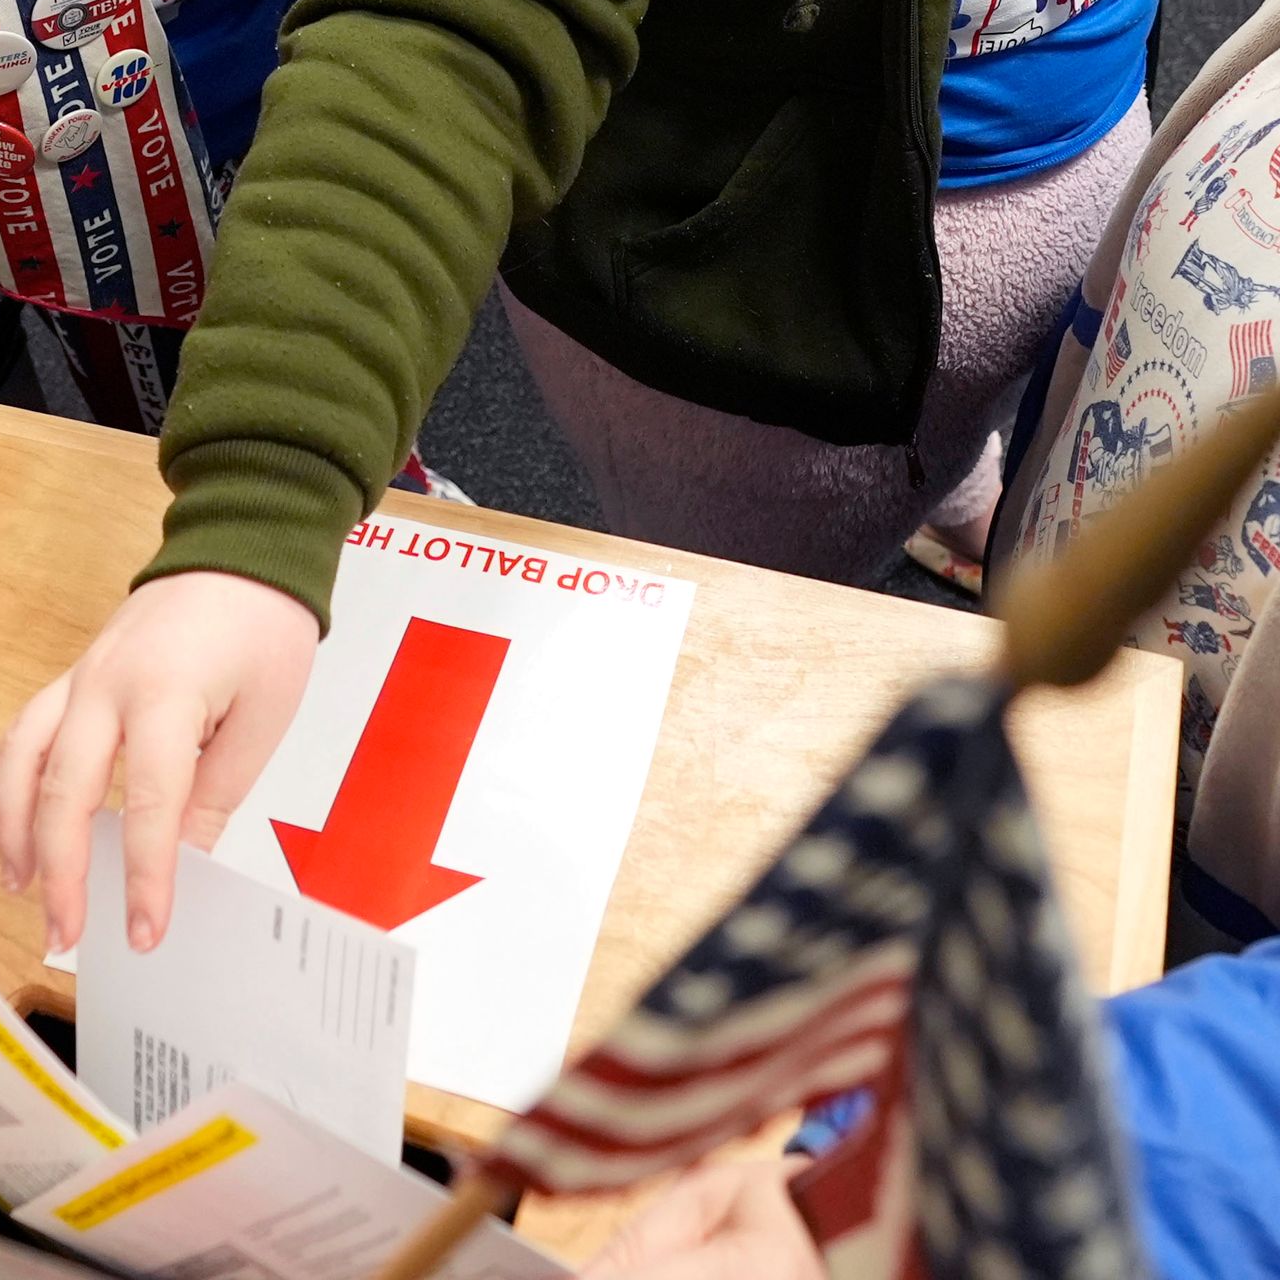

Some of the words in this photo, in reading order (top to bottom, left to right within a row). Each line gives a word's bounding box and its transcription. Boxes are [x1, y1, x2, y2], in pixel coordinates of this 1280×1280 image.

[42, 54, 86, 119] OTE
[101, 67, 152, 92] VOTE
[43, 123, 66, 153] STUDENT
[137, 108, 176, 197] VOTE
[83, 207, 123, 285] VOTE
[1129, 271, 1208, 380] freedom
[1070, 429, 1092, 539] FREEDO
[344, 522, 395, 550] HE
[398, 532, 549, 584] BALLOT
[556, 566, 666, 609] DROP
